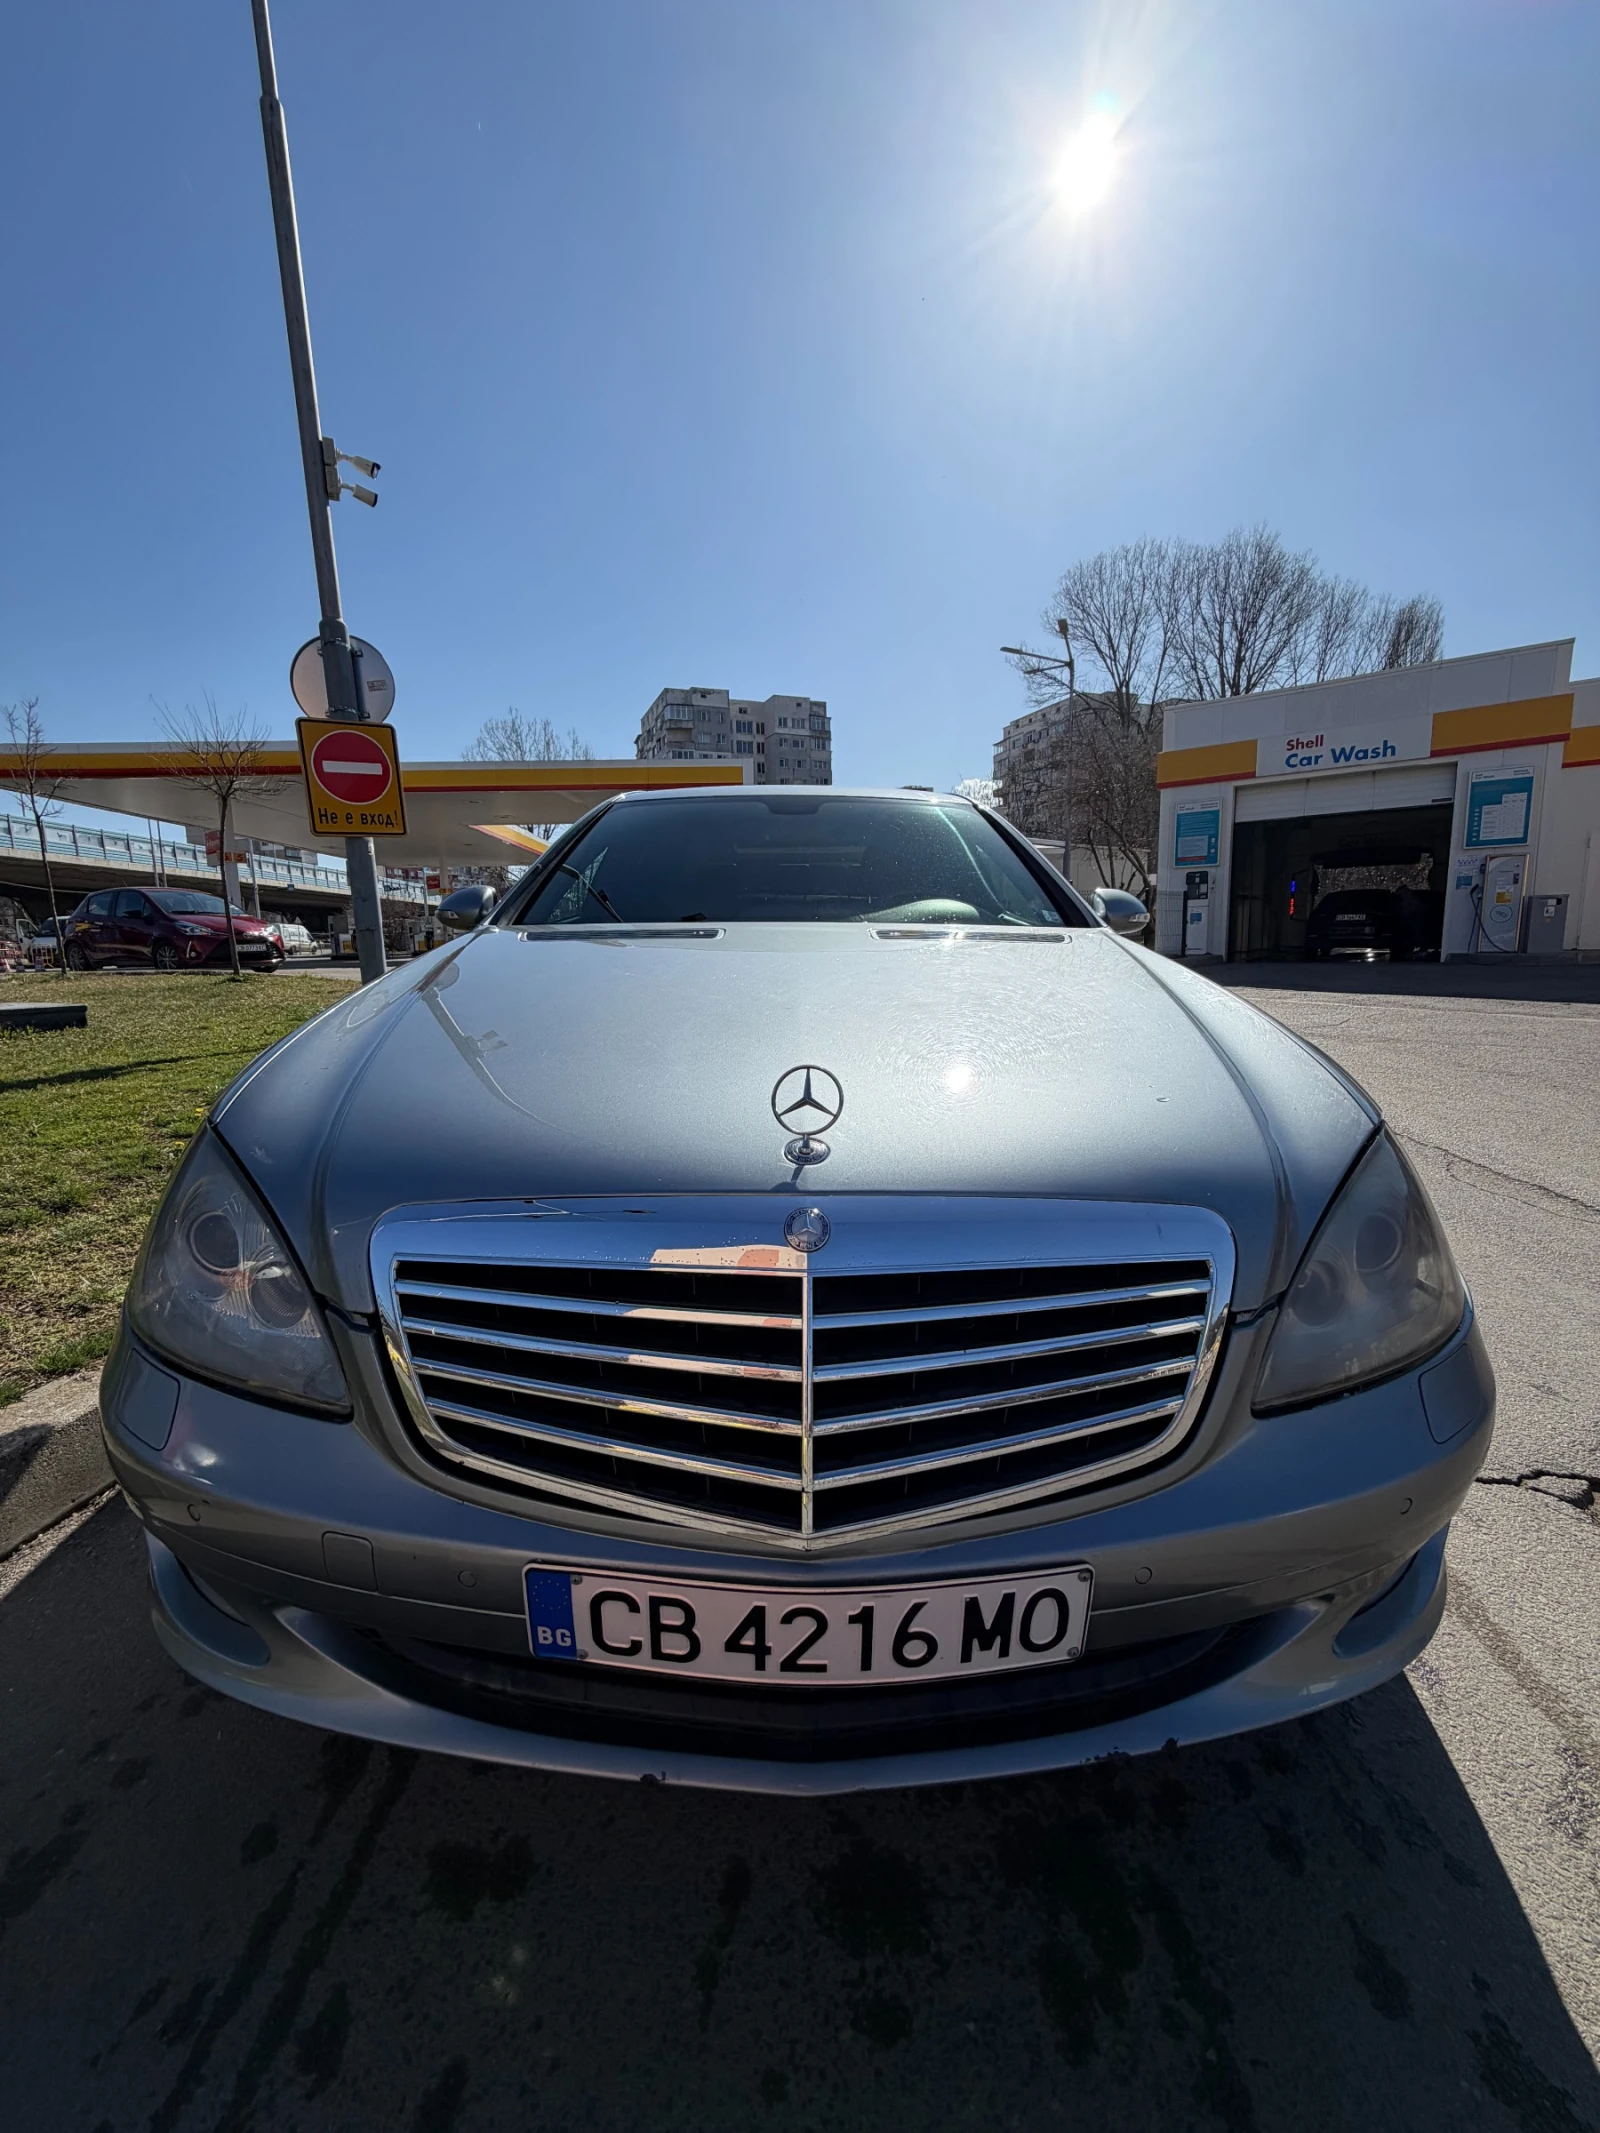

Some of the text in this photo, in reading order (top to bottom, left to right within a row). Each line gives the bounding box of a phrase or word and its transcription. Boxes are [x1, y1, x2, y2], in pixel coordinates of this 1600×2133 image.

[1286, 734, 1324, 751] Shell
[1285, 740, 1396, 768] Car Wash
[318, 807, 399, 828] Не е вход!
[537, 1626, 571, 1647] BG
[589, 1587, 1069, 1672] CB 4216 MO
